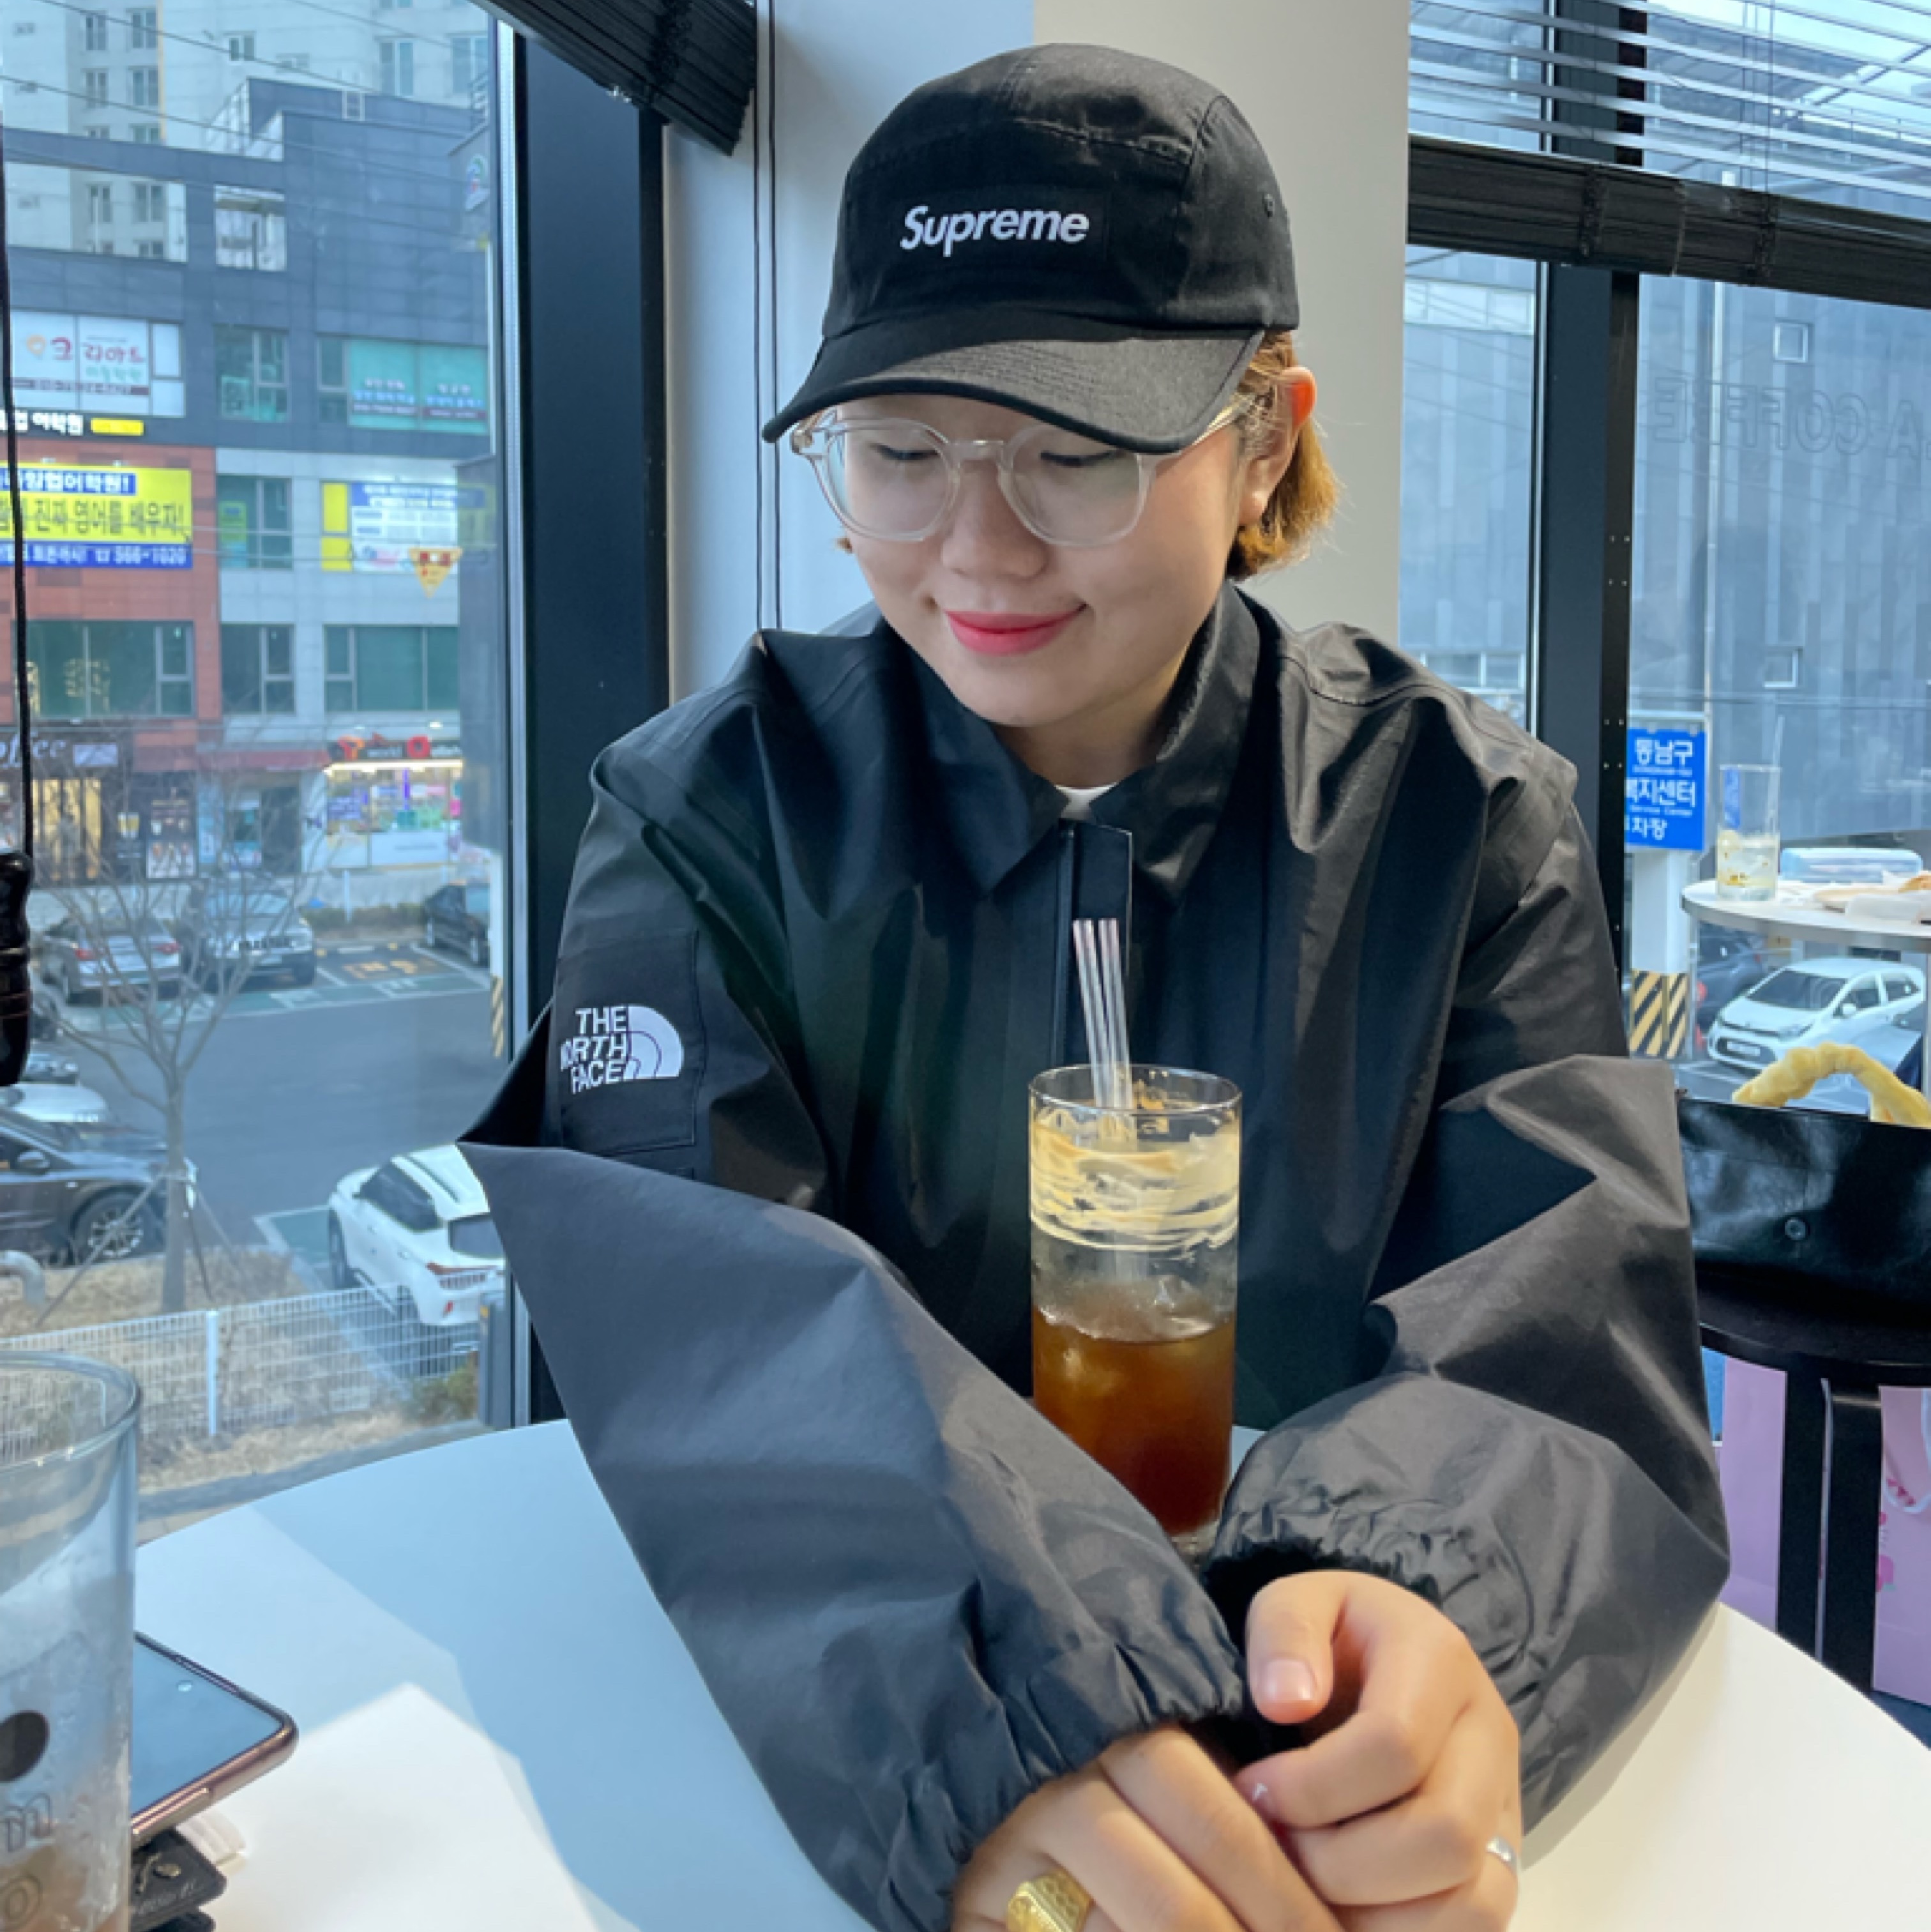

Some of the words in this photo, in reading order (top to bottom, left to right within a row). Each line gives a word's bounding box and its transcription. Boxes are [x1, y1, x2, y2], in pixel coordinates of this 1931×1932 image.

[900, 204, 1089, 257] Supreme
[32, 412, 84, 436] 어학원
[34, 498, 68, 535] 진짜
[75, 499, 122, 536] 영어를
[129, 501, 185, 537] 배우자!
[1634, 737, 1693, 765] 동남구
[1625, 816, 1668, 841] 차장
[575, 1005, 627, 1035] THE
